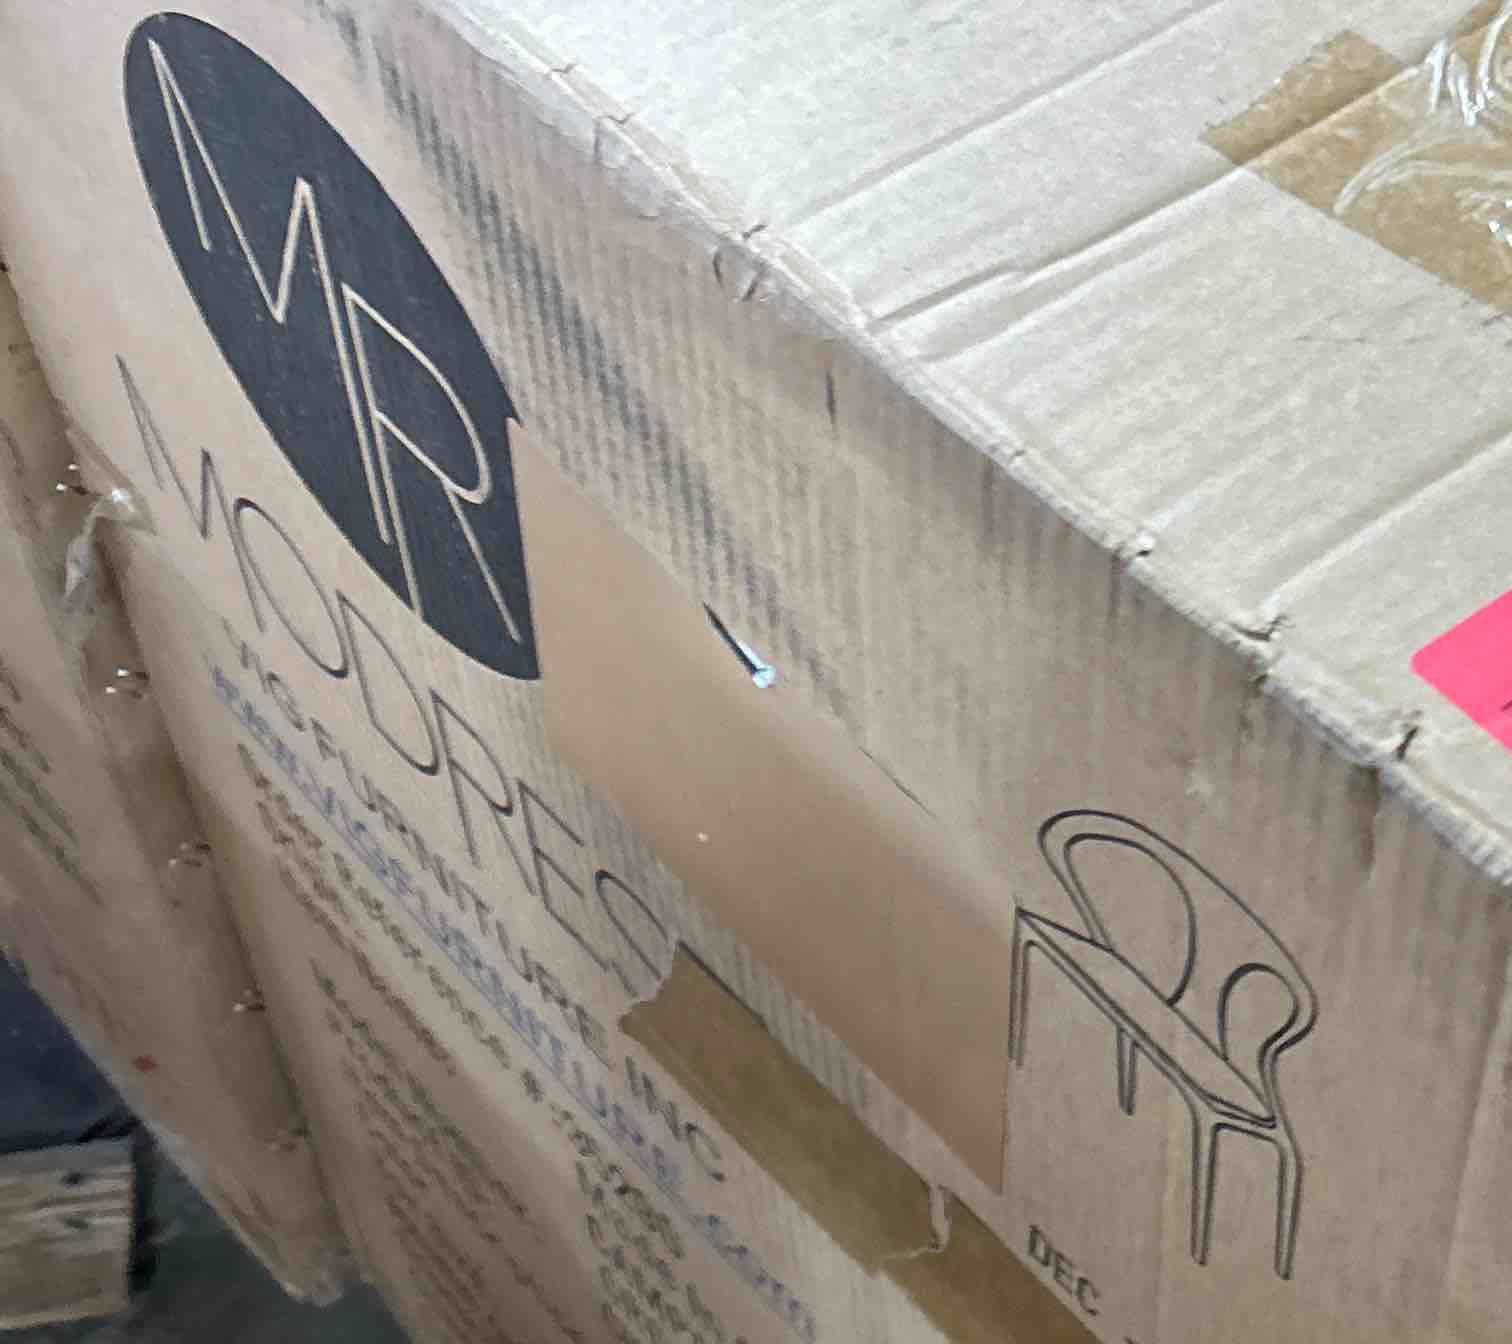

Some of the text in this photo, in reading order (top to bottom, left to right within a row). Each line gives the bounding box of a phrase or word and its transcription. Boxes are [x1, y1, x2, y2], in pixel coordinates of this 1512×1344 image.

[309, 715, 613, 1072] FURNITURE
[625, 1054, 727, 1184] INC
[1028, 1224, 1100, 1316] DEC
